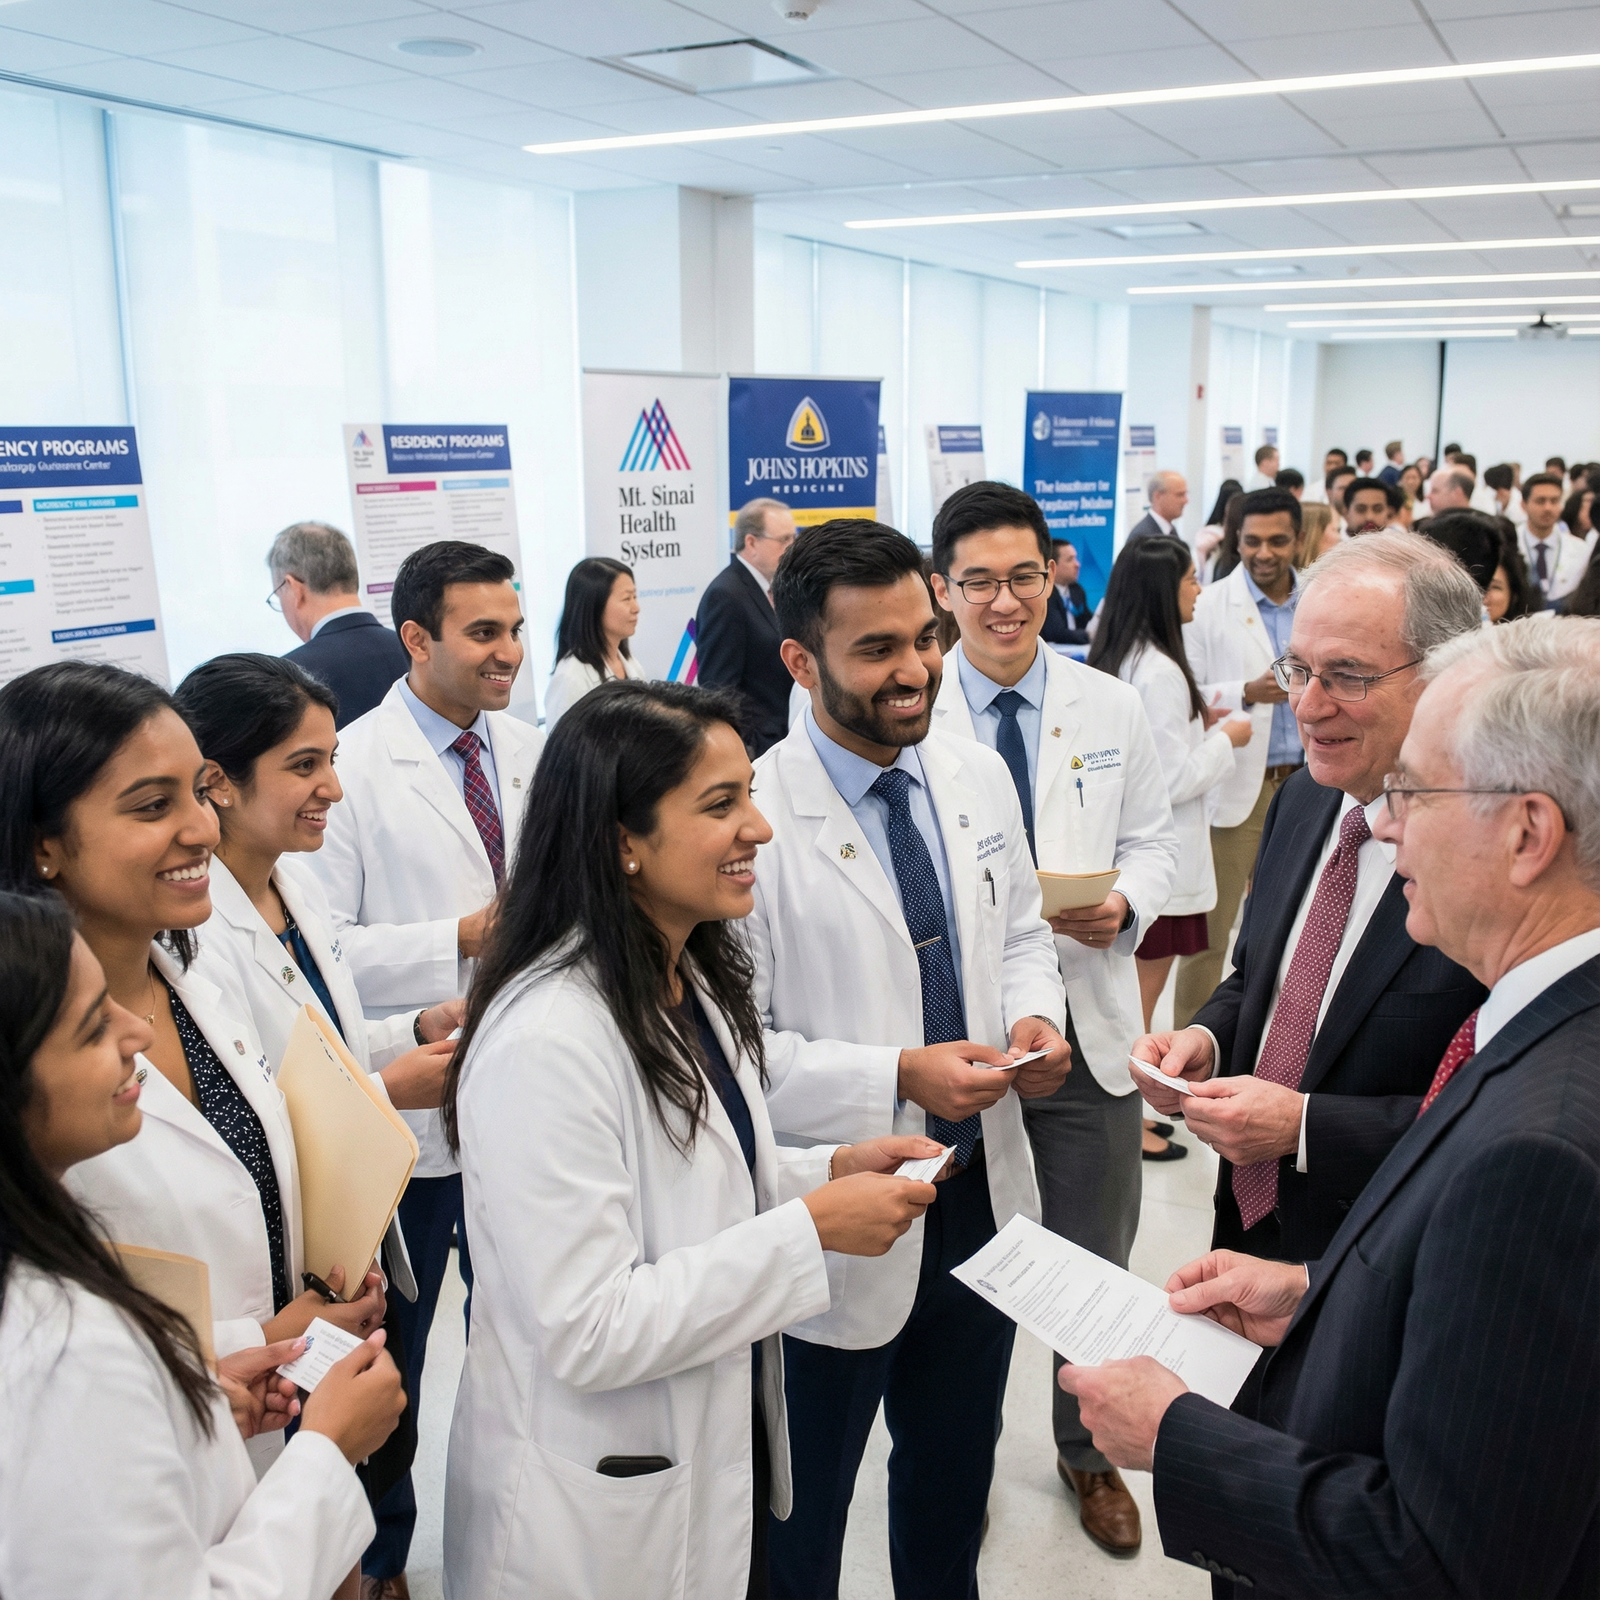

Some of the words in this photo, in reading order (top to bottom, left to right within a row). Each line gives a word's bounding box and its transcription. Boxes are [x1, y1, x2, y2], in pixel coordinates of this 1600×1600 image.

[42, 439, 129, 456] PROGRAMS
[390, 435, 448, 449] RESIDENCY
[449, 434, 505, 448] PROGRAMS
[744, 457, 797, 486] JOHNS
[800, 456, 869, 479] HOPKINS
[618, 486, 646, 507] Mt.
[652, 483, 695, 506] Sinai
[772, 484, 844, 494] MEDICINE
[620, 510, 676, 534] Health
[620, 539, 682, 568] System
